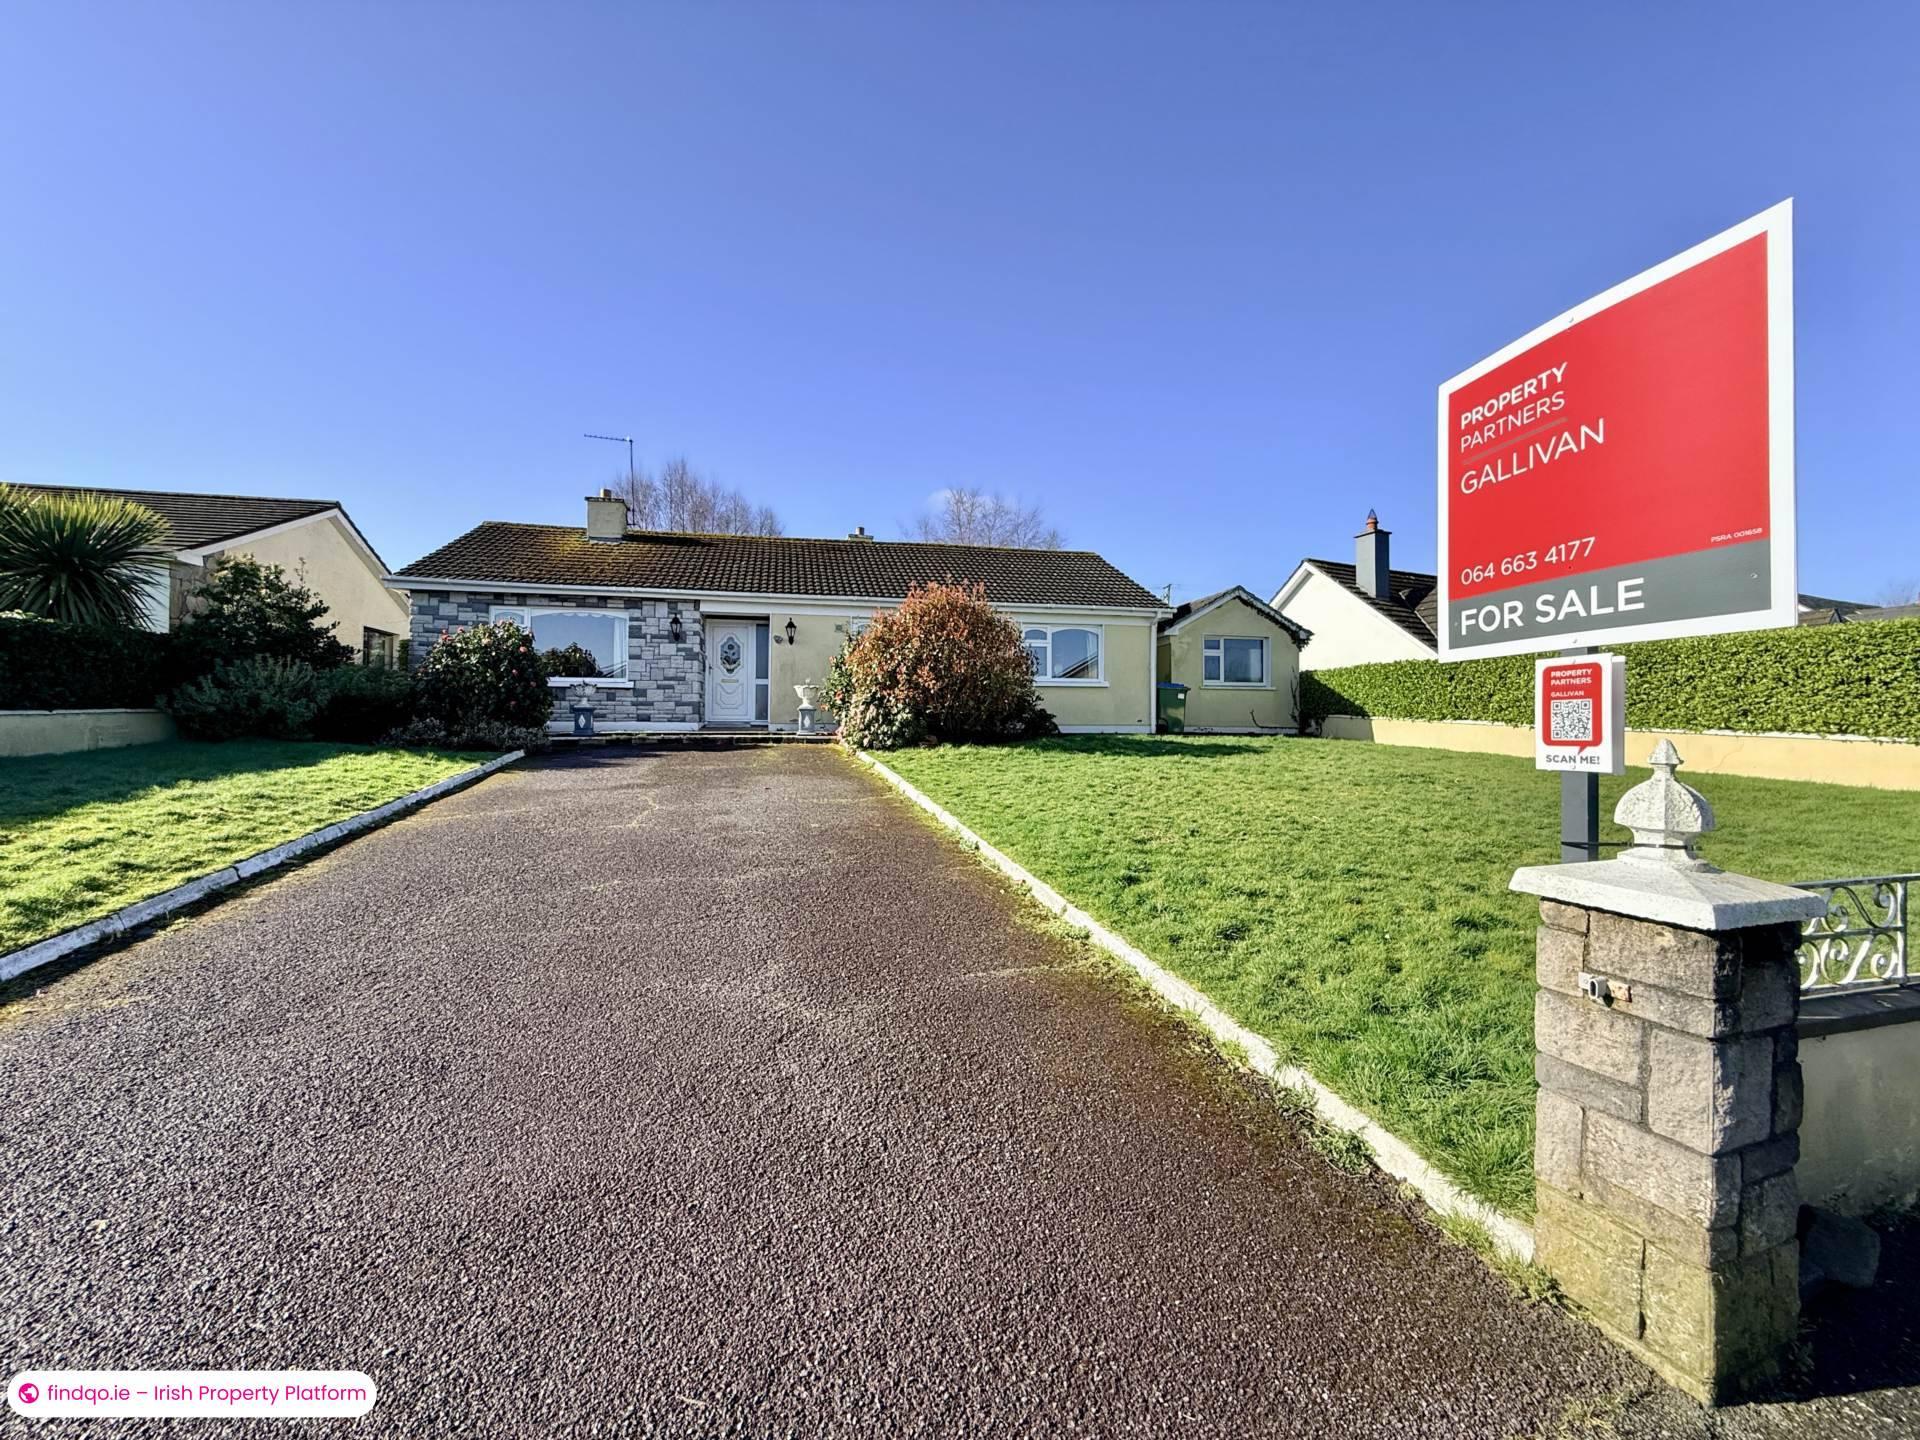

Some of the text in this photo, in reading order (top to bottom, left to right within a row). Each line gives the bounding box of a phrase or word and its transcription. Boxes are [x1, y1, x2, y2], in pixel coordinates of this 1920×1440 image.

[1460, 362, 1568, 430] PROPERTY
[1460, 391, 1566, 453] PARTNERS
[1460, 418, 1605, 495] GALLIVAN
[1460, 536, 1596, 586] 064 663 4177
[1711, 534, 1732, 543] PSRA
[1460, 577, 1645, 635] FOR SALE
[1551, 669, 1592, 678] PROPERTY
[1551, 677, 1592, 686] PARTNERS
[1546, 755, 1600, 765] SCAN ME!
